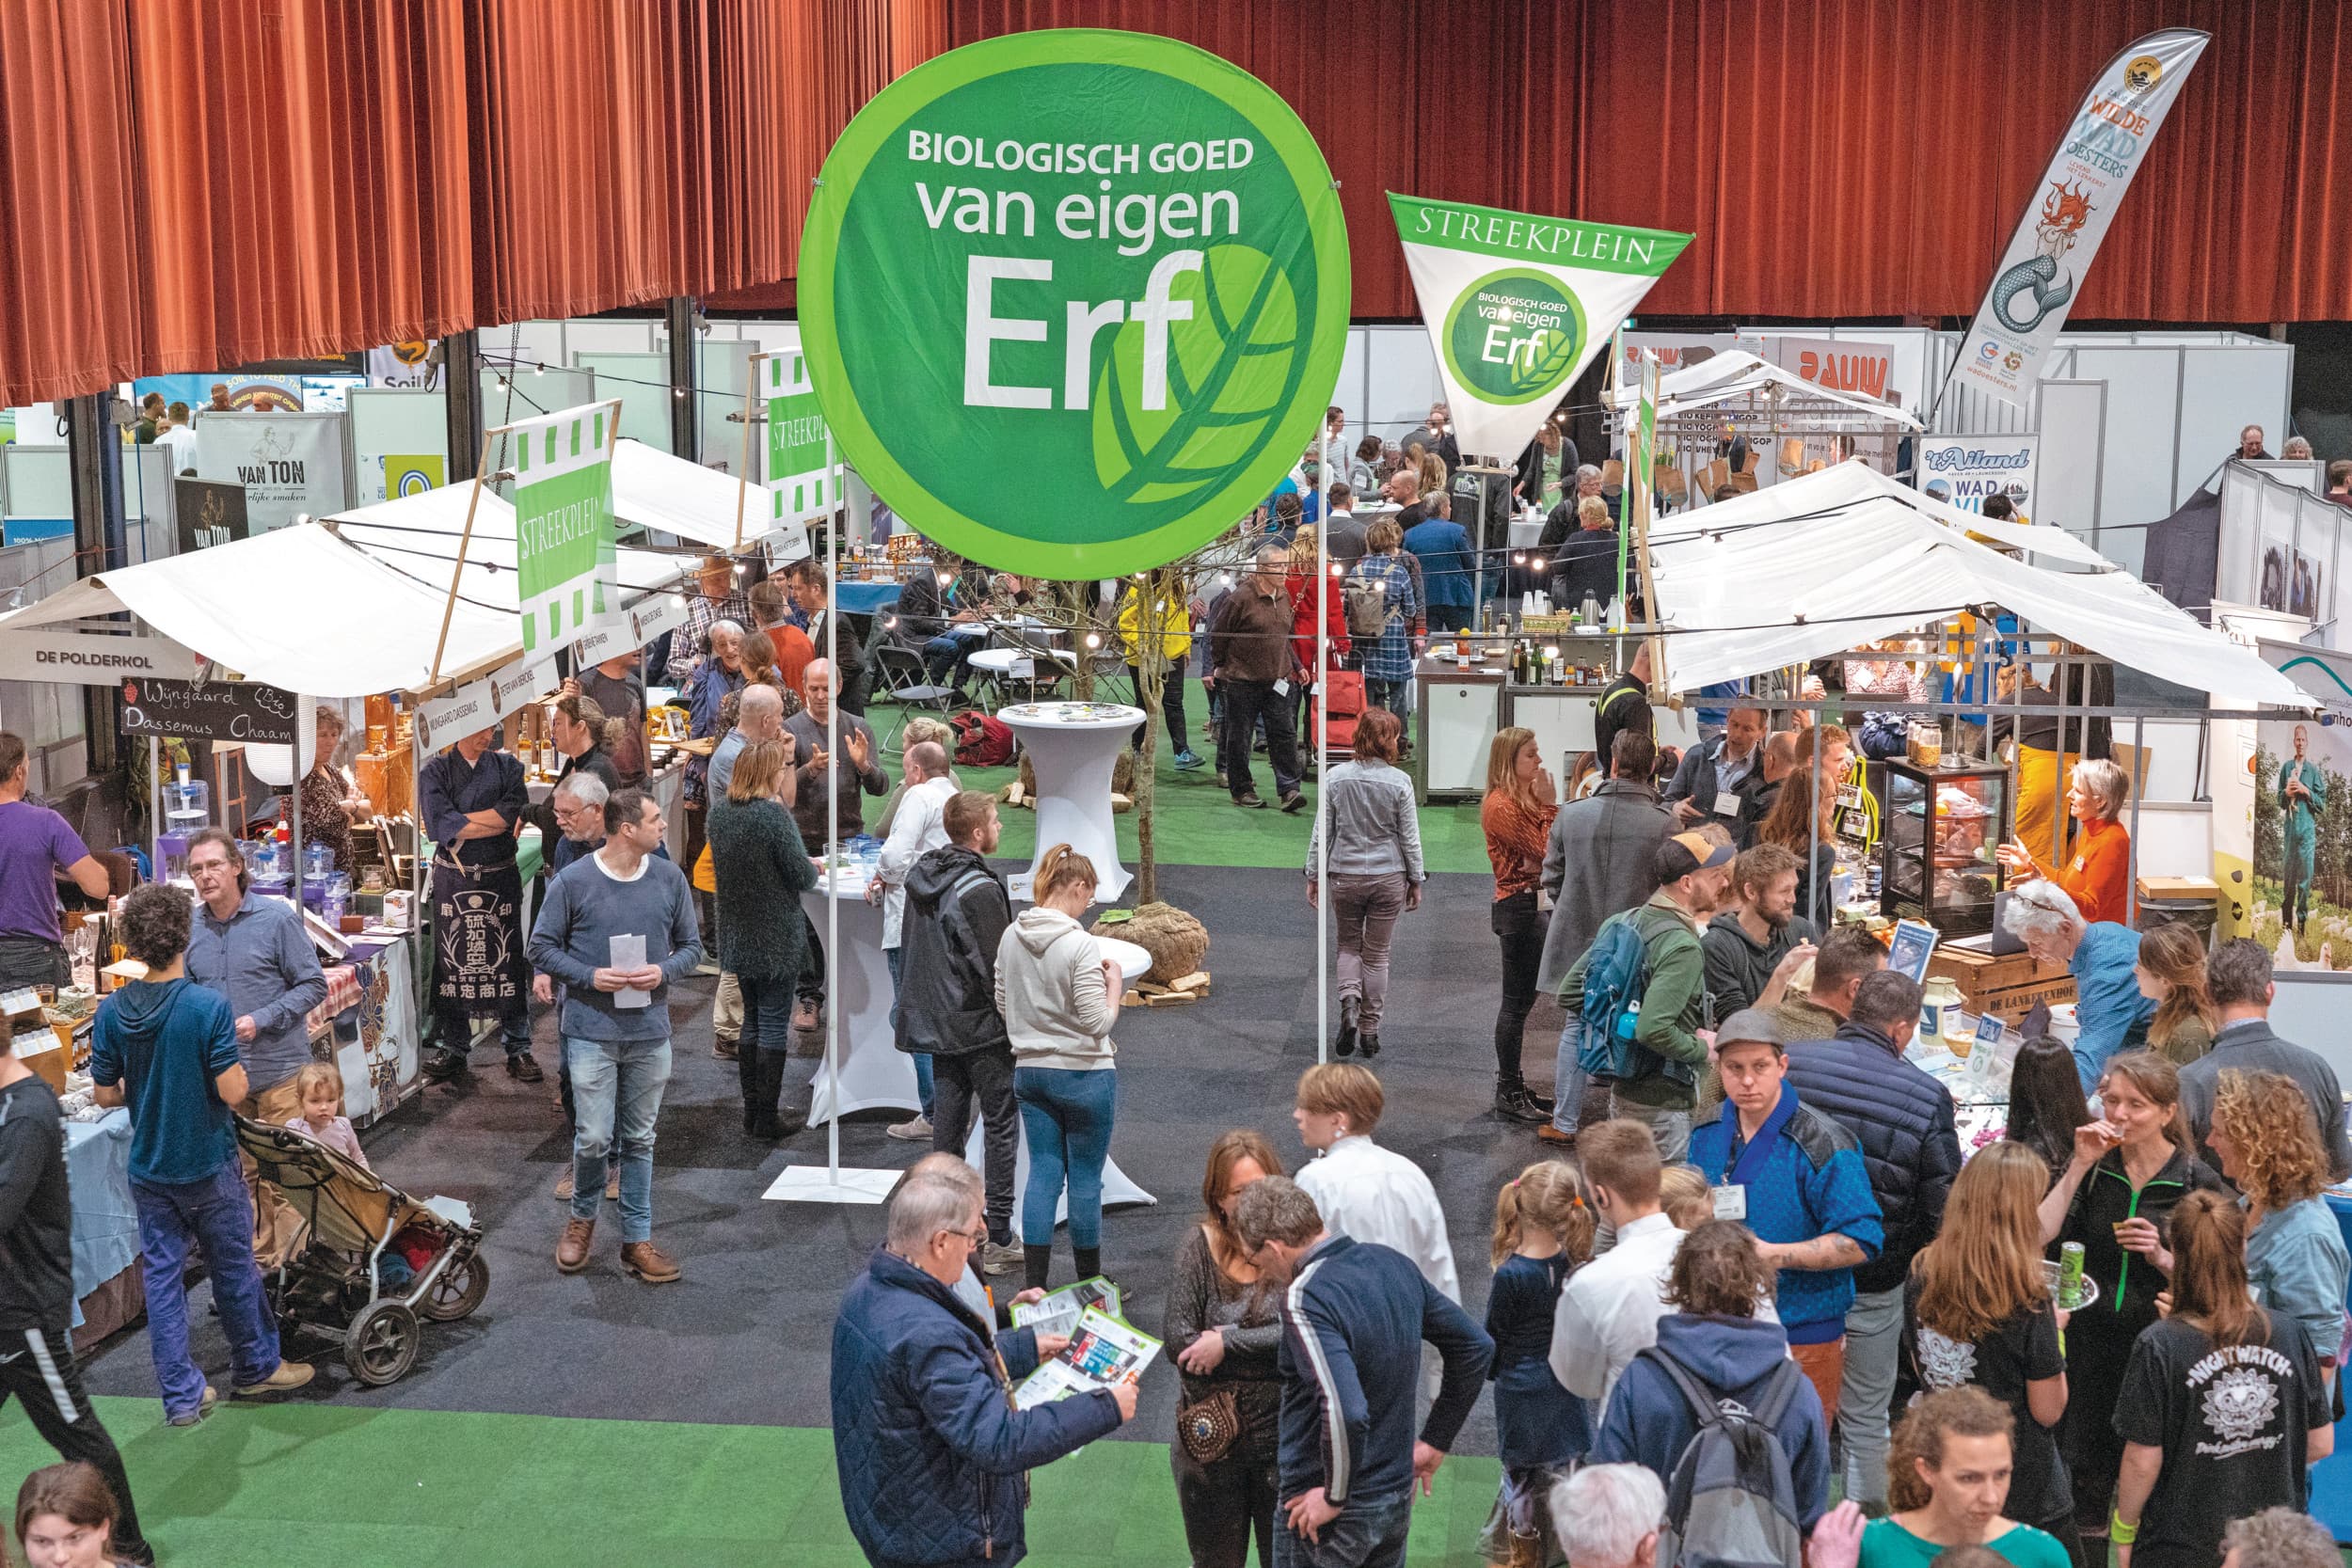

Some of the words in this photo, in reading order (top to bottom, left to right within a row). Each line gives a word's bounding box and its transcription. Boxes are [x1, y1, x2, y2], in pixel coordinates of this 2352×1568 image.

[2090, 95, 2150, 136] WILDE
[2073, 113, 2137, 160] WAD
[908, 130, 1139, 174] BIOLOGISCH
[1149, 138, 1254, 173] GOED
[2066, 141, 2128, 179] OESTERS
[915, 182, 1035, 236] van
[1055, 179, 1239, 256] eigen
[1415, 206, 1656, 265] STREEKPLEIN
[1478, 292, 1538, 309] BIOLOGISCH
[1539, 301, 1567, 312] GOED
[1478, 306, 1511, 321] va
[1512, 309, 1561, 329] eigen
[963, 248, 1204, 411] Erf
[1482, 324, 1549, 367] Erf
[1800, 351, 1887, 399] RAUW
[237, 466, 265, 483] VAN
[268, 460, 305, 483] TON
[272, 491, 307, 501] smaken
[1956, 480, 1997, 496] WAD
[194, 529, 211, 548] VAN
[210, 525, 230, 546] TON
[37, 650, 56, 663] DE
[60, 652, 153, 669] POLDERKOL
[263, 688, 286, 709] Bio
[452, 701, 478, 723] DASSEMUS
[125, 706, 213, 735] Dassemus
[230, 714, 294, 742] Chaam
[500, 903, 512, 916] 印
[1991, 999, 2003, 1011] DE
